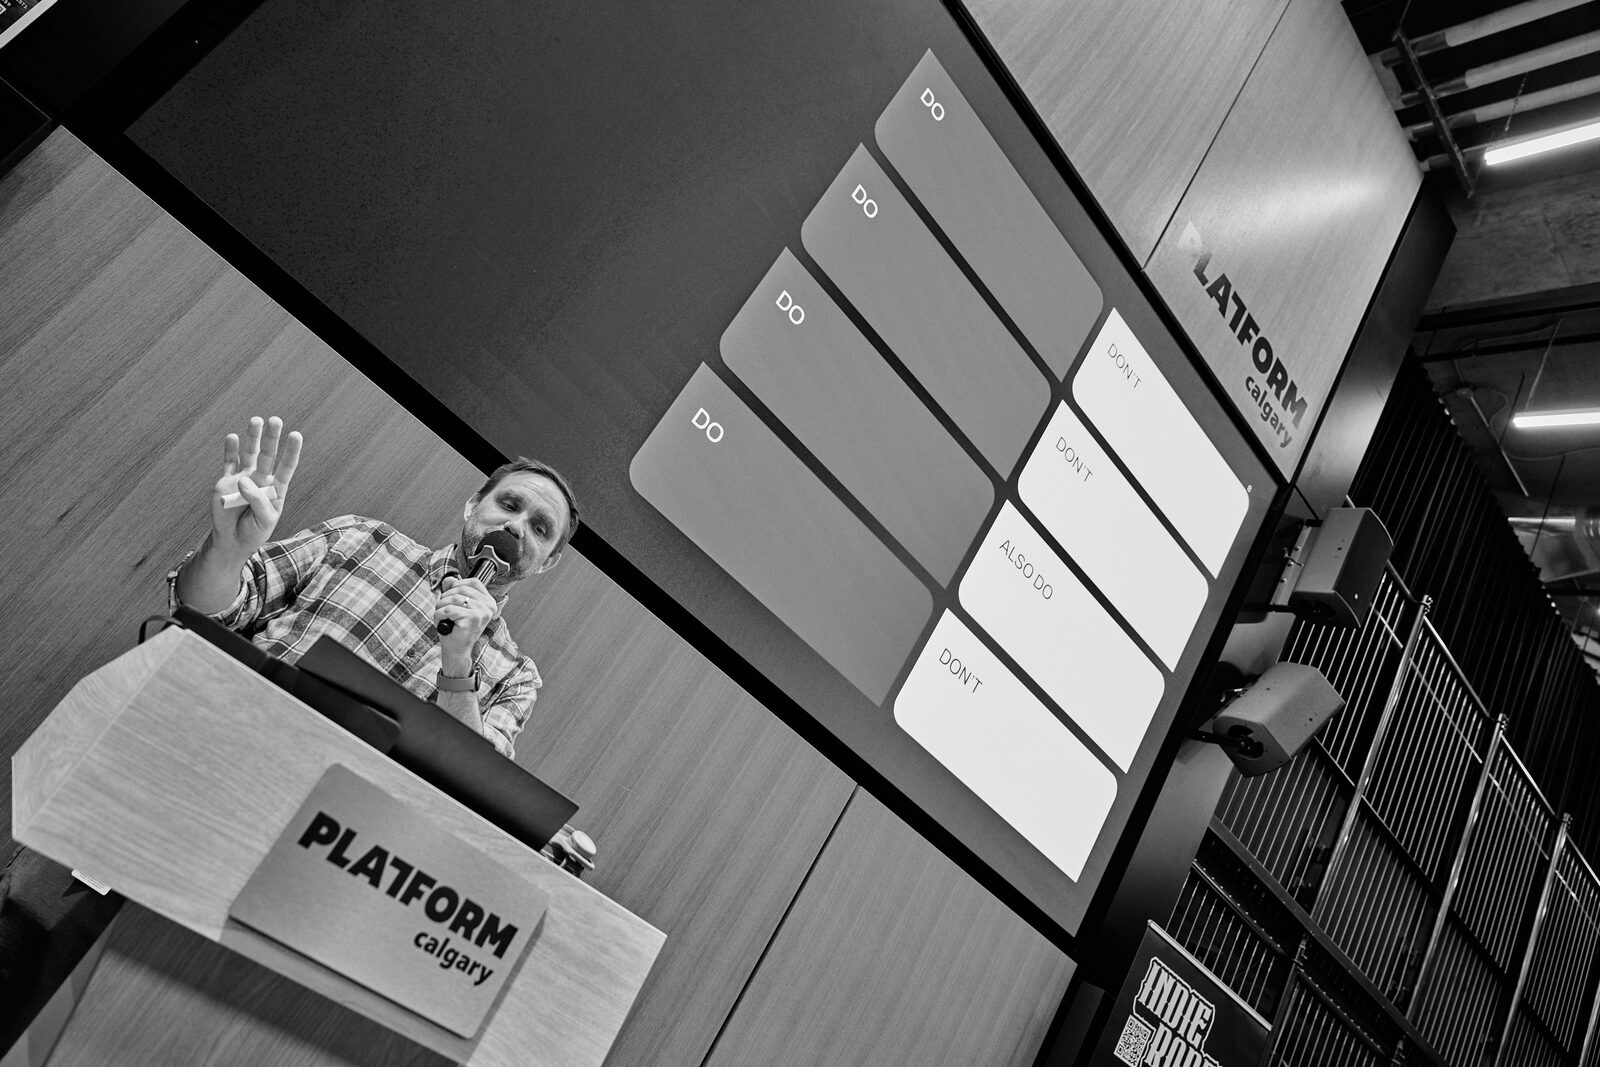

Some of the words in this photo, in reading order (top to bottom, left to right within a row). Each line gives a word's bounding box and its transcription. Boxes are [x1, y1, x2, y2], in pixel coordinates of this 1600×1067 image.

[920, 88, 945, 122] DO
[851, 184, 879, 219] DO
[775, 290, 805, 326] DO
[1177, 219, 1308, 427] PLATFORM
[1107, 343, 1142, 389] DON'T
[691, 407, 725, 443] DO
[1245, 376, 1293, 449] calgary
[1055, 436, 1094, 482] DON'T
[999, 539, 1035, 579] ALSO
[1033, 573, 1054, 600] DO
[938, 647, 983, 694] DON'T
[297, 811, 519, 960] PLATFORM
[413, 932, 494, 987] calgary
[1137, 961, 1213, 1049] INDIE
